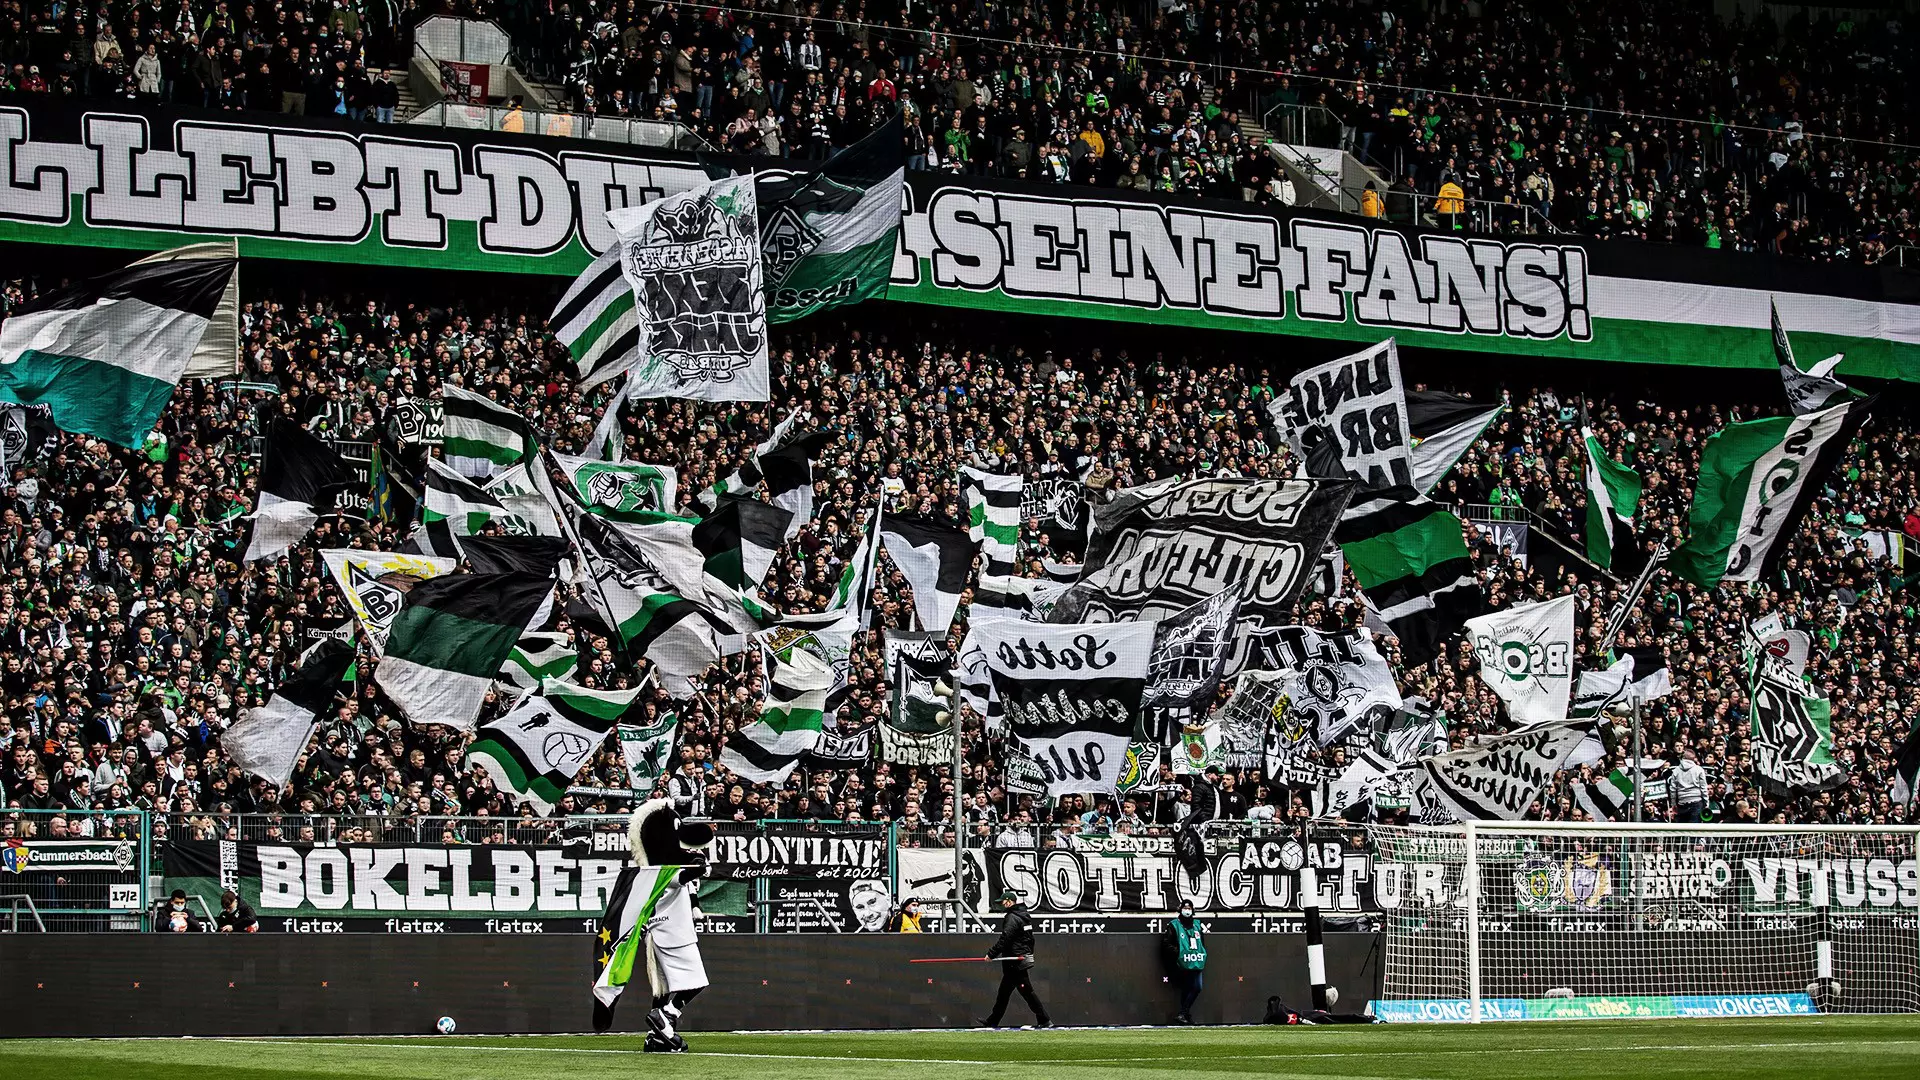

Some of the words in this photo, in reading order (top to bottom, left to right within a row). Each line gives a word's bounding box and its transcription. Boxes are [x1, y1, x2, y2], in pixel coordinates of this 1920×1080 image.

[82, 111, 461, 251] LEBT
[929, 185, 1285, 320] SEINE
[1290, 218, 1592, 343] FANS!
[709, 835, 882, 868] FRONTLINE
[1073, 834, 1218, 854] ASCENDEE
[1409, 838, 1517, 854] STADIONERBOT
[28, 849, 113, 862] Gummersbach
[256, 841, 640, 911] BÖKELBER
[816, 866, 840, 878] seit
[843, 867, 880, 878] 2006
[112, 891, 137, 903] 17/2
[283, 918, 344, 933] flatex
[385, 918, 445, 933] flatex
[485, 918, 544, 933] flatex
[694, 921, 736, 933] atex
[1039, 919, 1106, 933] flatex
[1251, 918, 1306, 933] flate
[1755, 917, 1797, 930] flatex
[1891, 916, 1917, 929] flat
[1183, 953, 1205, 962] HOST
[1416, 1001, 1500, 1020] JONGEN
[1712, 997, 1792, 1016] JONGEN
